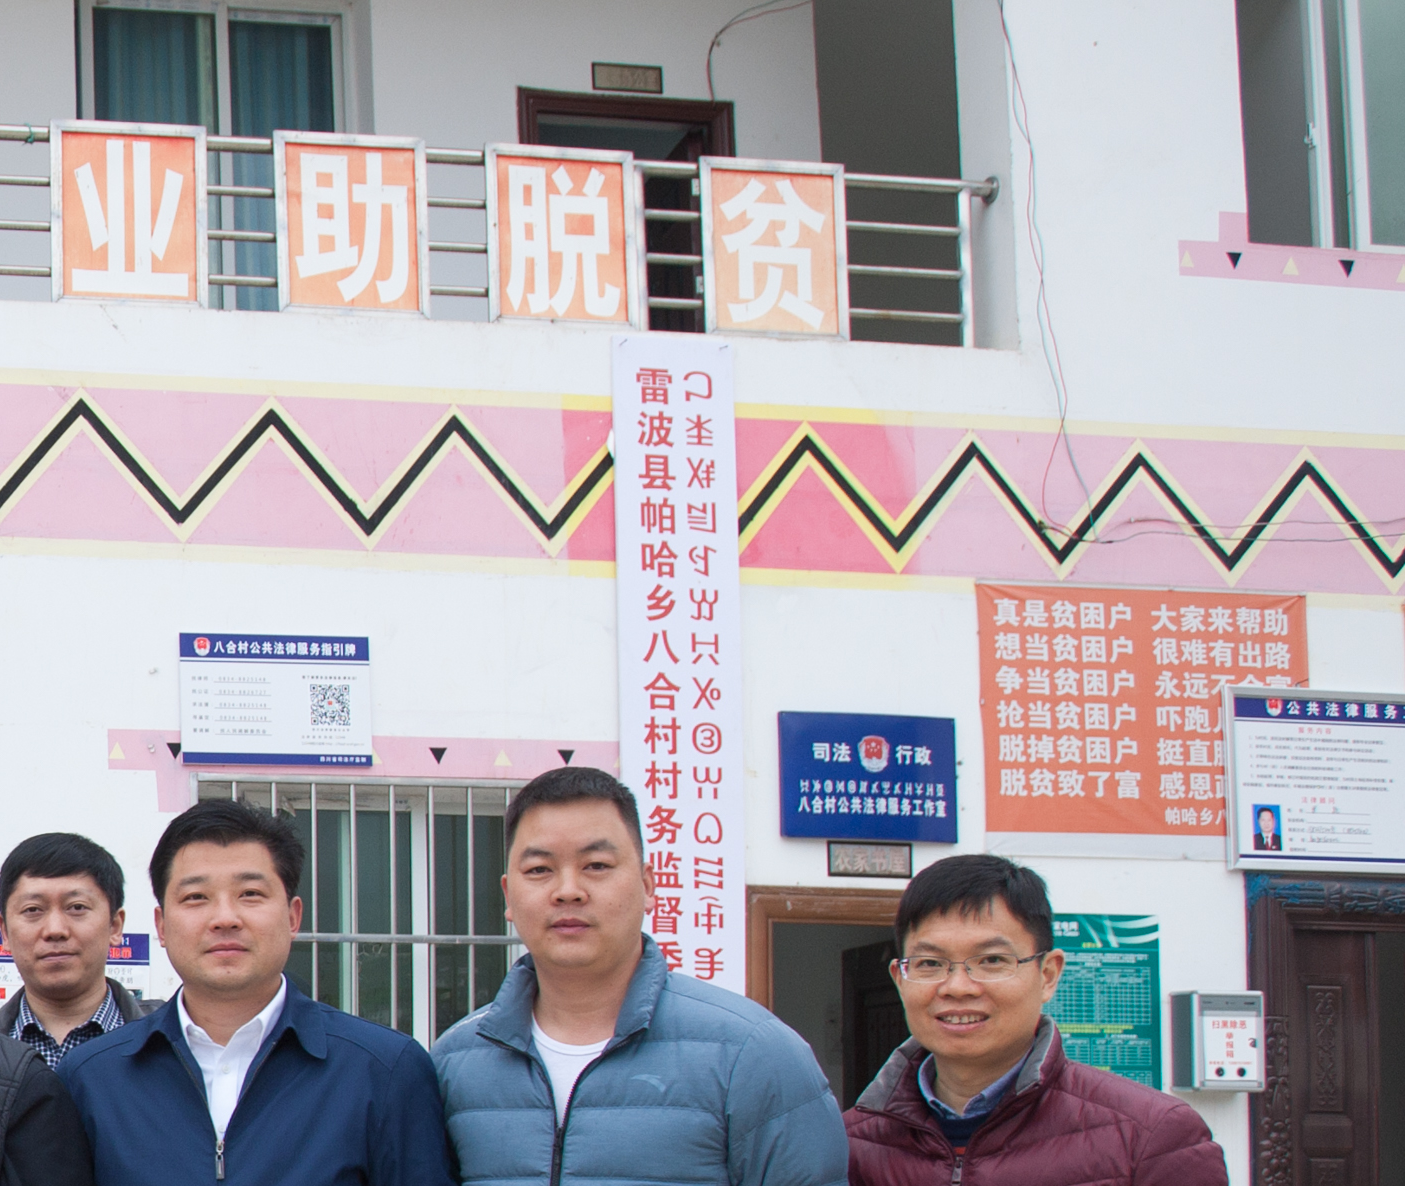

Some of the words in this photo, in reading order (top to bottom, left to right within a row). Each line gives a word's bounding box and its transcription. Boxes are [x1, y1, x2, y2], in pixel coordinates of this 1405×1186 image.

[993, 599, 1133, 630] 真是贫困户
[1151, 604, 1288, 636] 大家来帮助
[214, 641, 357, 657] 八合村公共法律服务指引牌
[994, 633, 1134, 664] 想当贫困户
[1152, 637, 1291, 670] 很难有出路
[995, 667, 1136, 698] 争当贫困户
[997, 700, 1137, 731] 抢当贫困户
[1287, 701, 1405, 720] 公共法律服务
[812, 742, 851, 762] 司法
[896, 745, 932, 766] 行政
[998, 734, 1138, 765] 脱掉贫困户
[1000, 768, 1142, 799] 脱贫致了富
[798, 795, 947, 818] 八合村公共法律服务工作室
[835, 848, 907, 874] 农家书屋
[1212, 1020, 1247, 1029] 扫黑除恶
